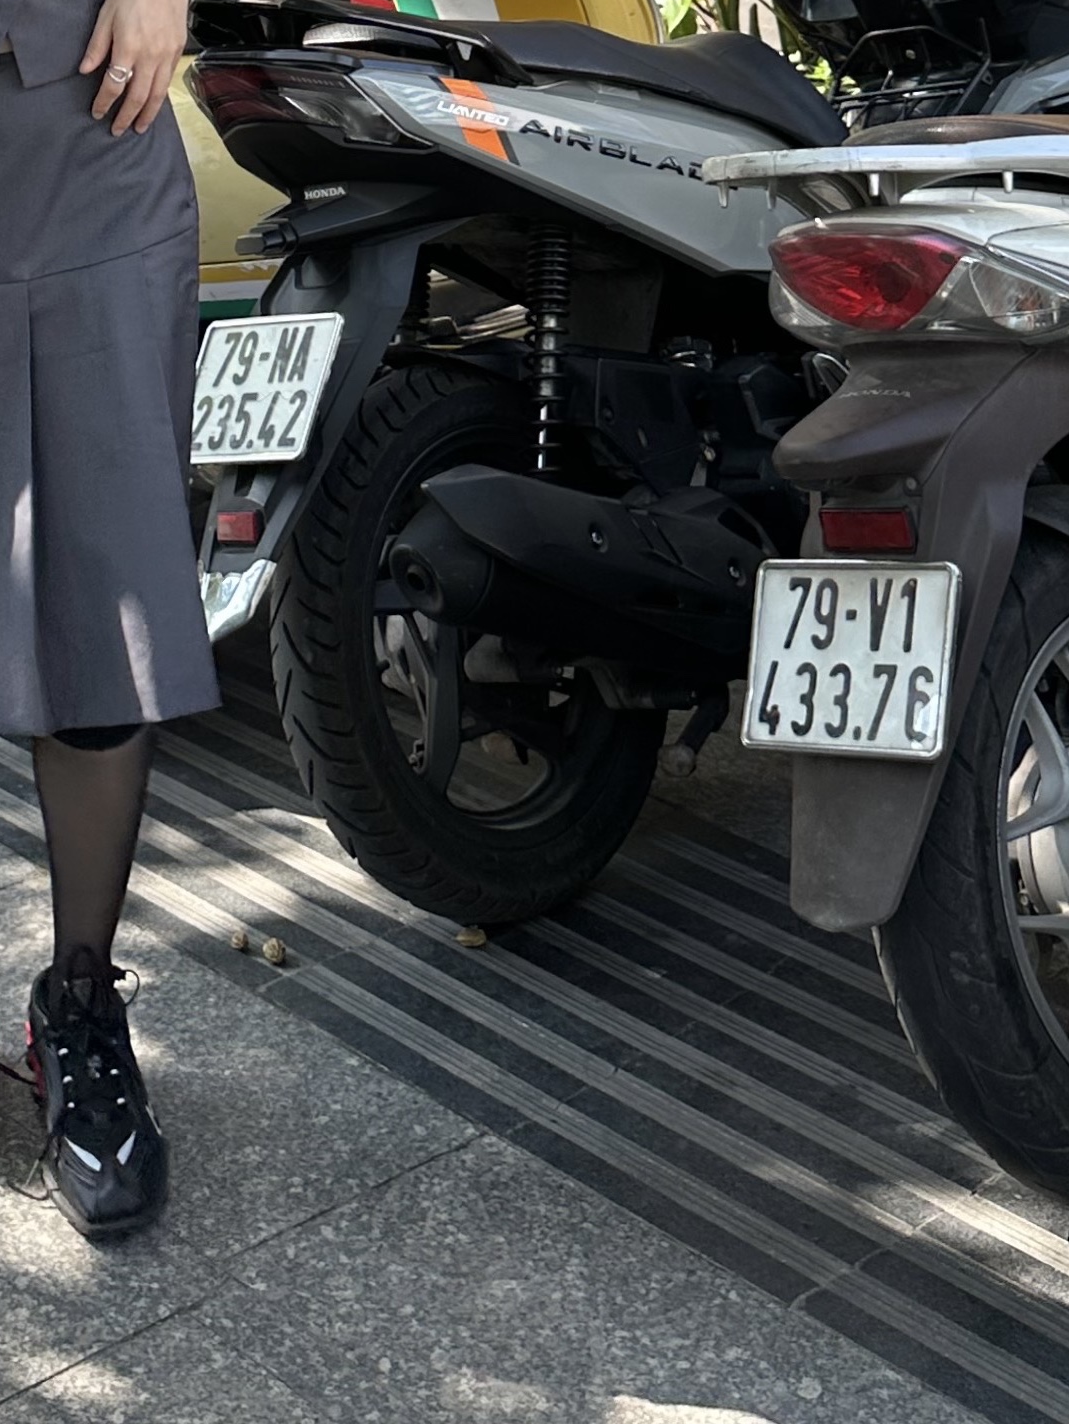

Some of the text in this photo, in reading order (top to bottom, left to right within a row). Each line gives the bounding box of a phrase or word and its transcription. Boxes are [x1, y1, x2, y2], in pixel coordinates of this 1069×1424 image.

[436, 99, 509, 126] LIMITED
[303, 186, 346, 200] HONDA
[212, 326, 315, 387] 79-NA
[192, 389, 307, 452] 235.42
[783, 578, 919, 653] 79-V1
[758, 661, 934, 742] 433.76
